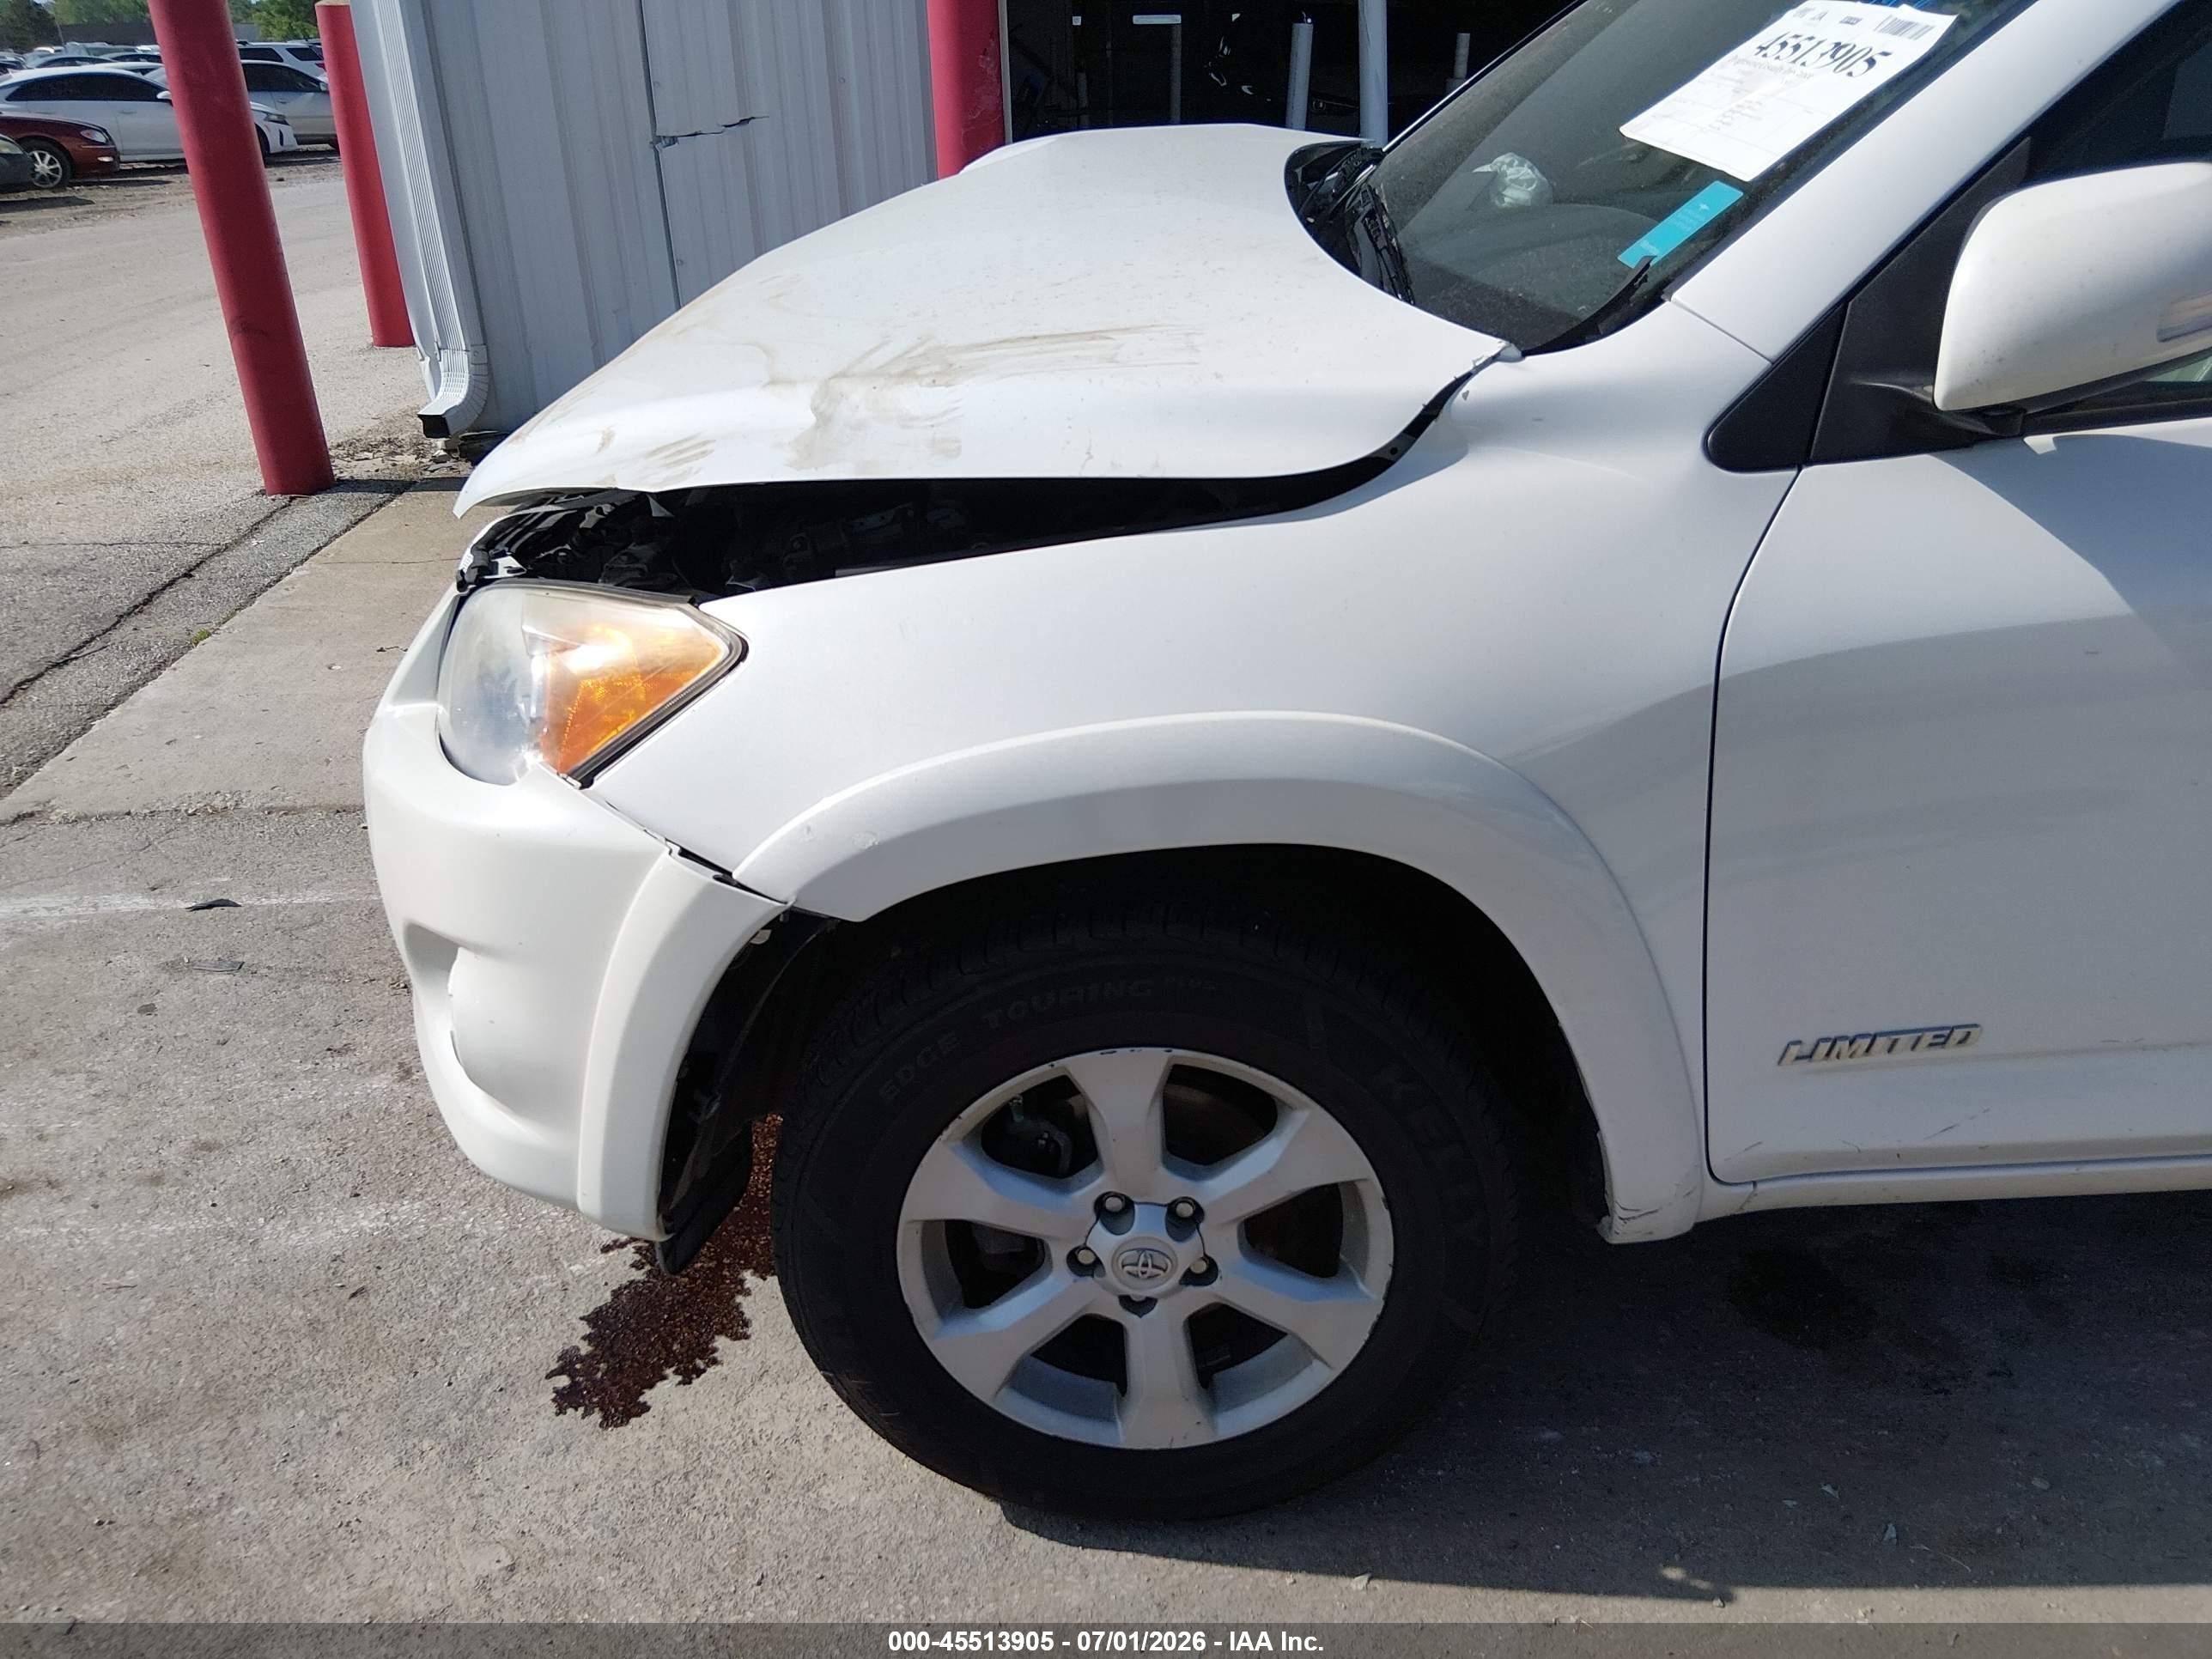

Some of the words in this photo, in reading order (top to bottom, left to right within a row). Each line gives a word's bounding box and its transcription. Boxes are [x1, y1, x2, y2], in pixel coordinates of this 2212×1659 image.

[1753, 31, 1893, 77] 45513905
[878, 1030, 963, 1105] EDGE
[981, 978, 1156, 1030] TOURING
[1778, 1023, 1983, 1066] LIMITED
